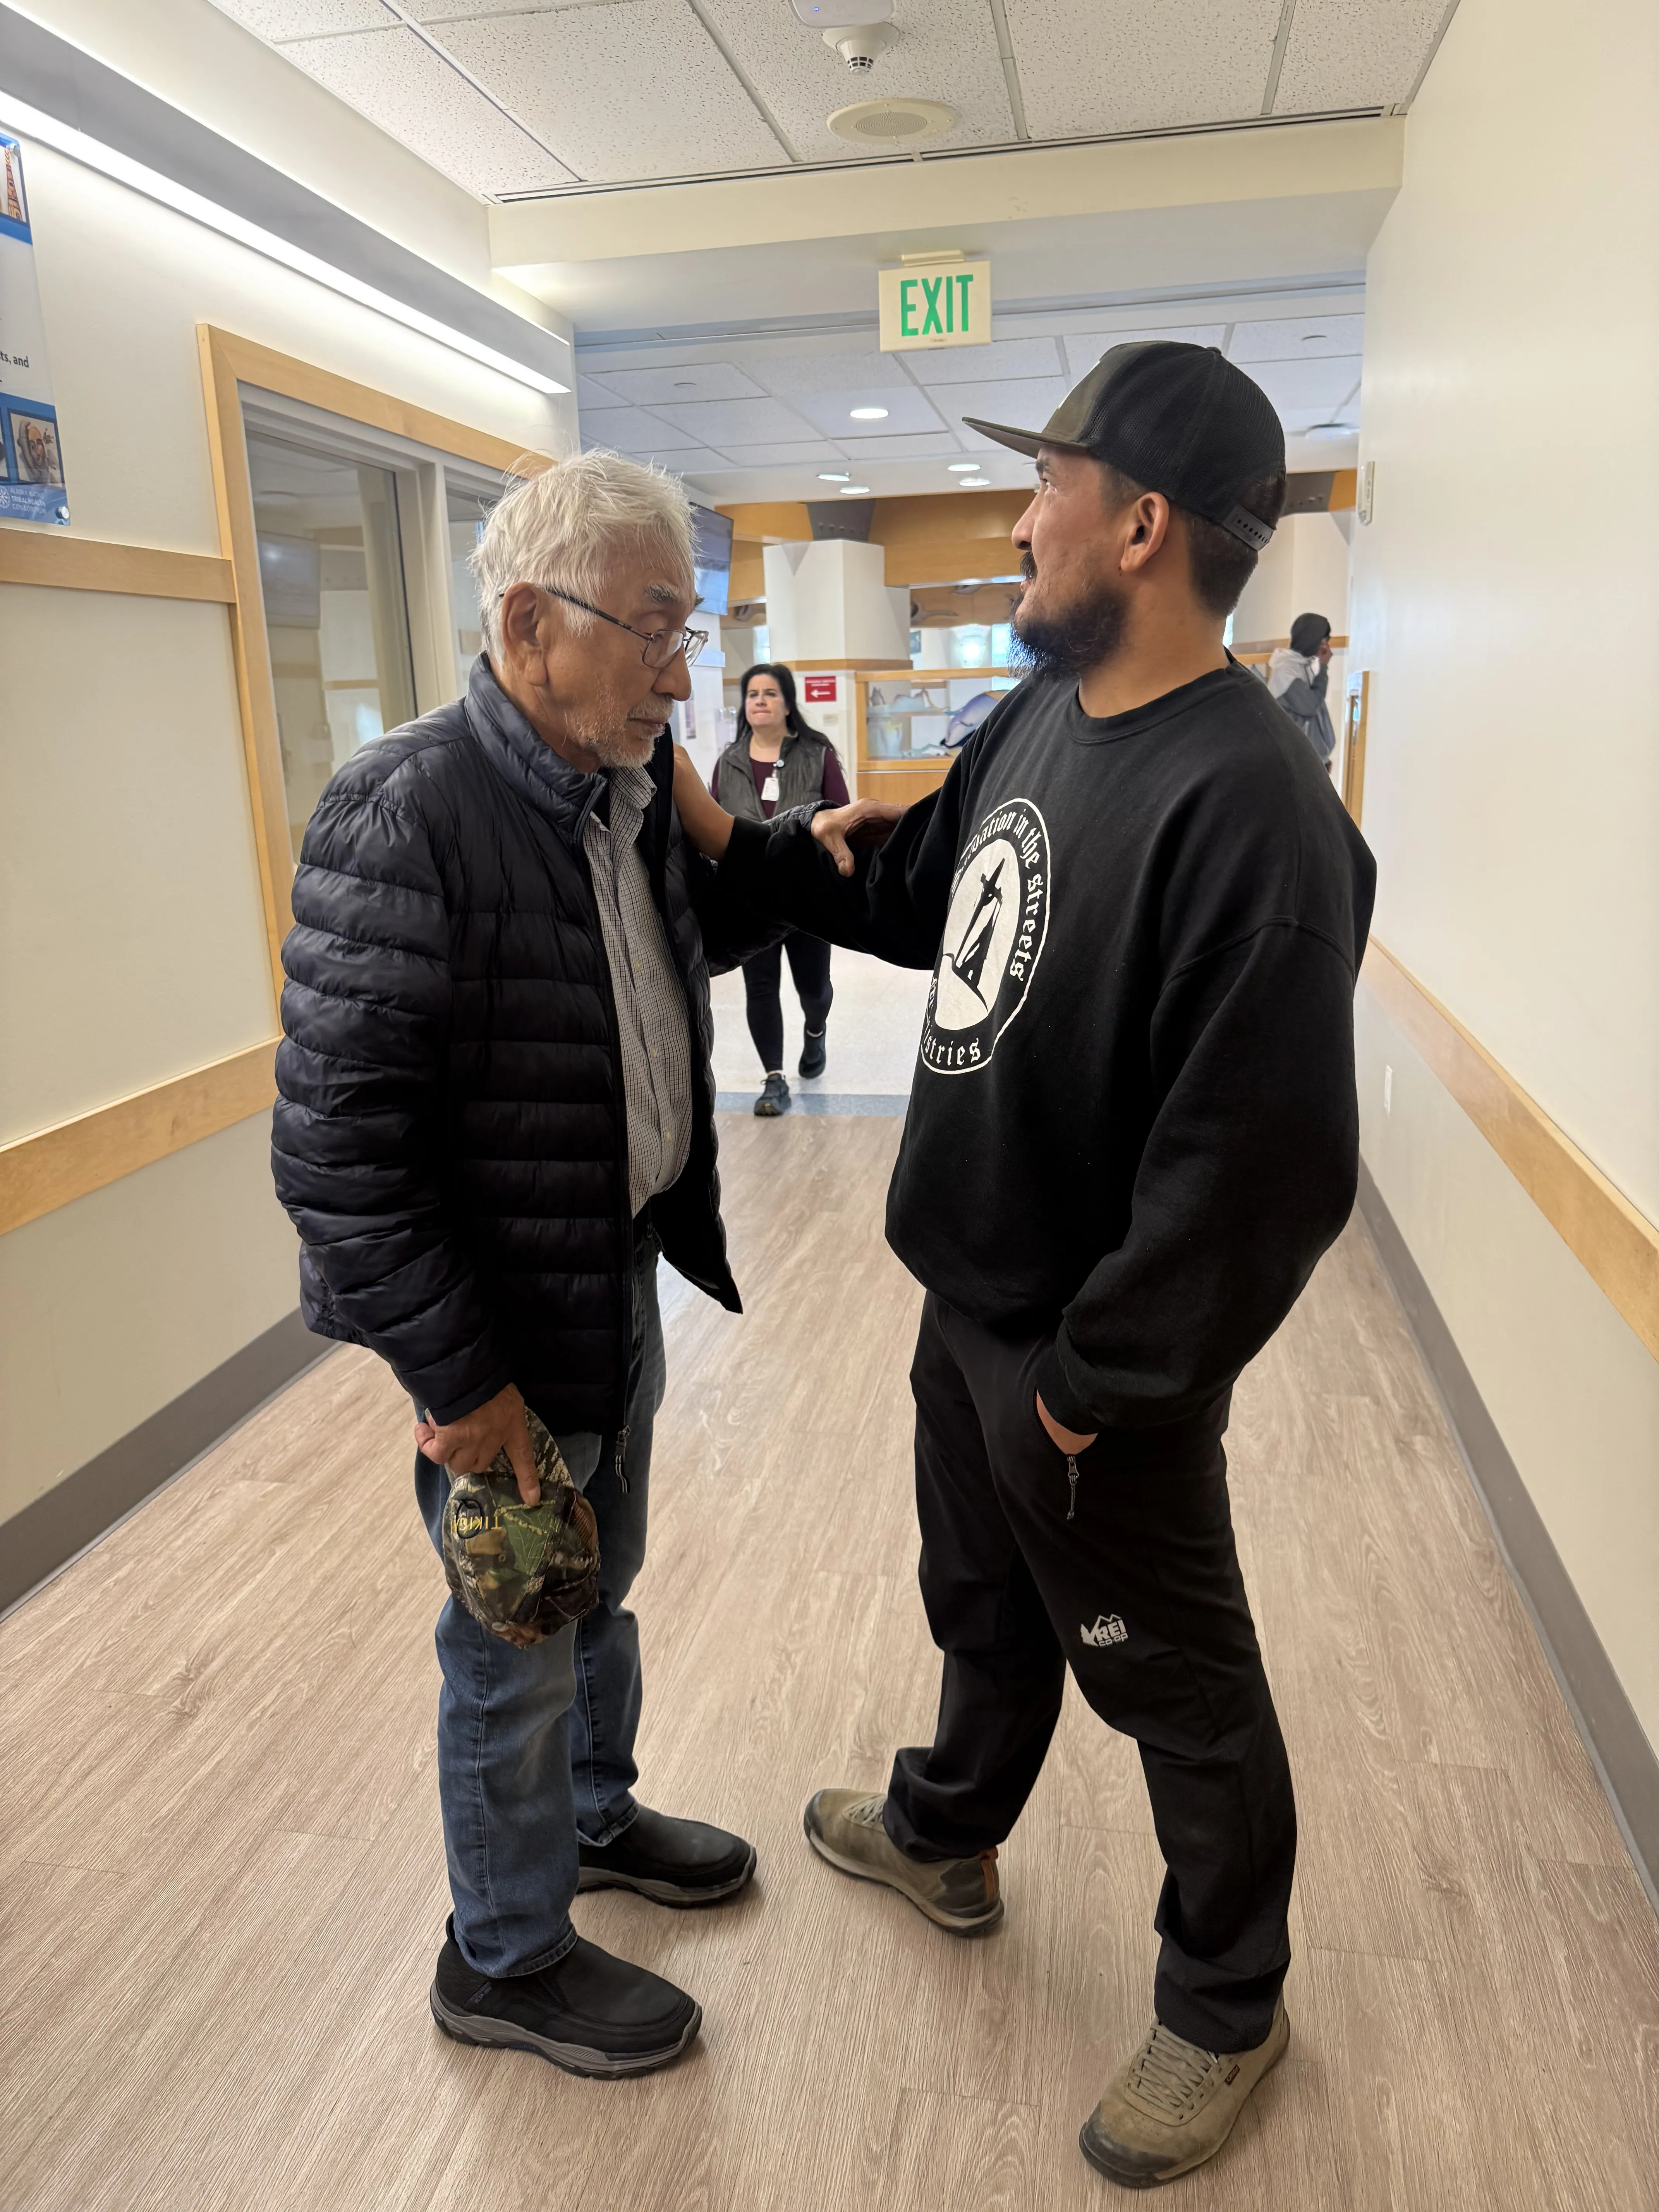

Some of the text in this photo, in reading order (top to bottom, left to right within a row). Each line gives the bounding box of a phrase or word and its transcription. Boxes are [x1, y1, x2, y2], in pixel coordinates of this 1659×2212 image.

[900, 274, 974, 337] EXIT
[0, 350, 29, 368] ts, and
[1013, 807, 1029, 839] in
[1019, 827, 1042, 869] the
[1009, 873, 1044, 982] streets
[1096, 1619, 1127, 1641] REI
